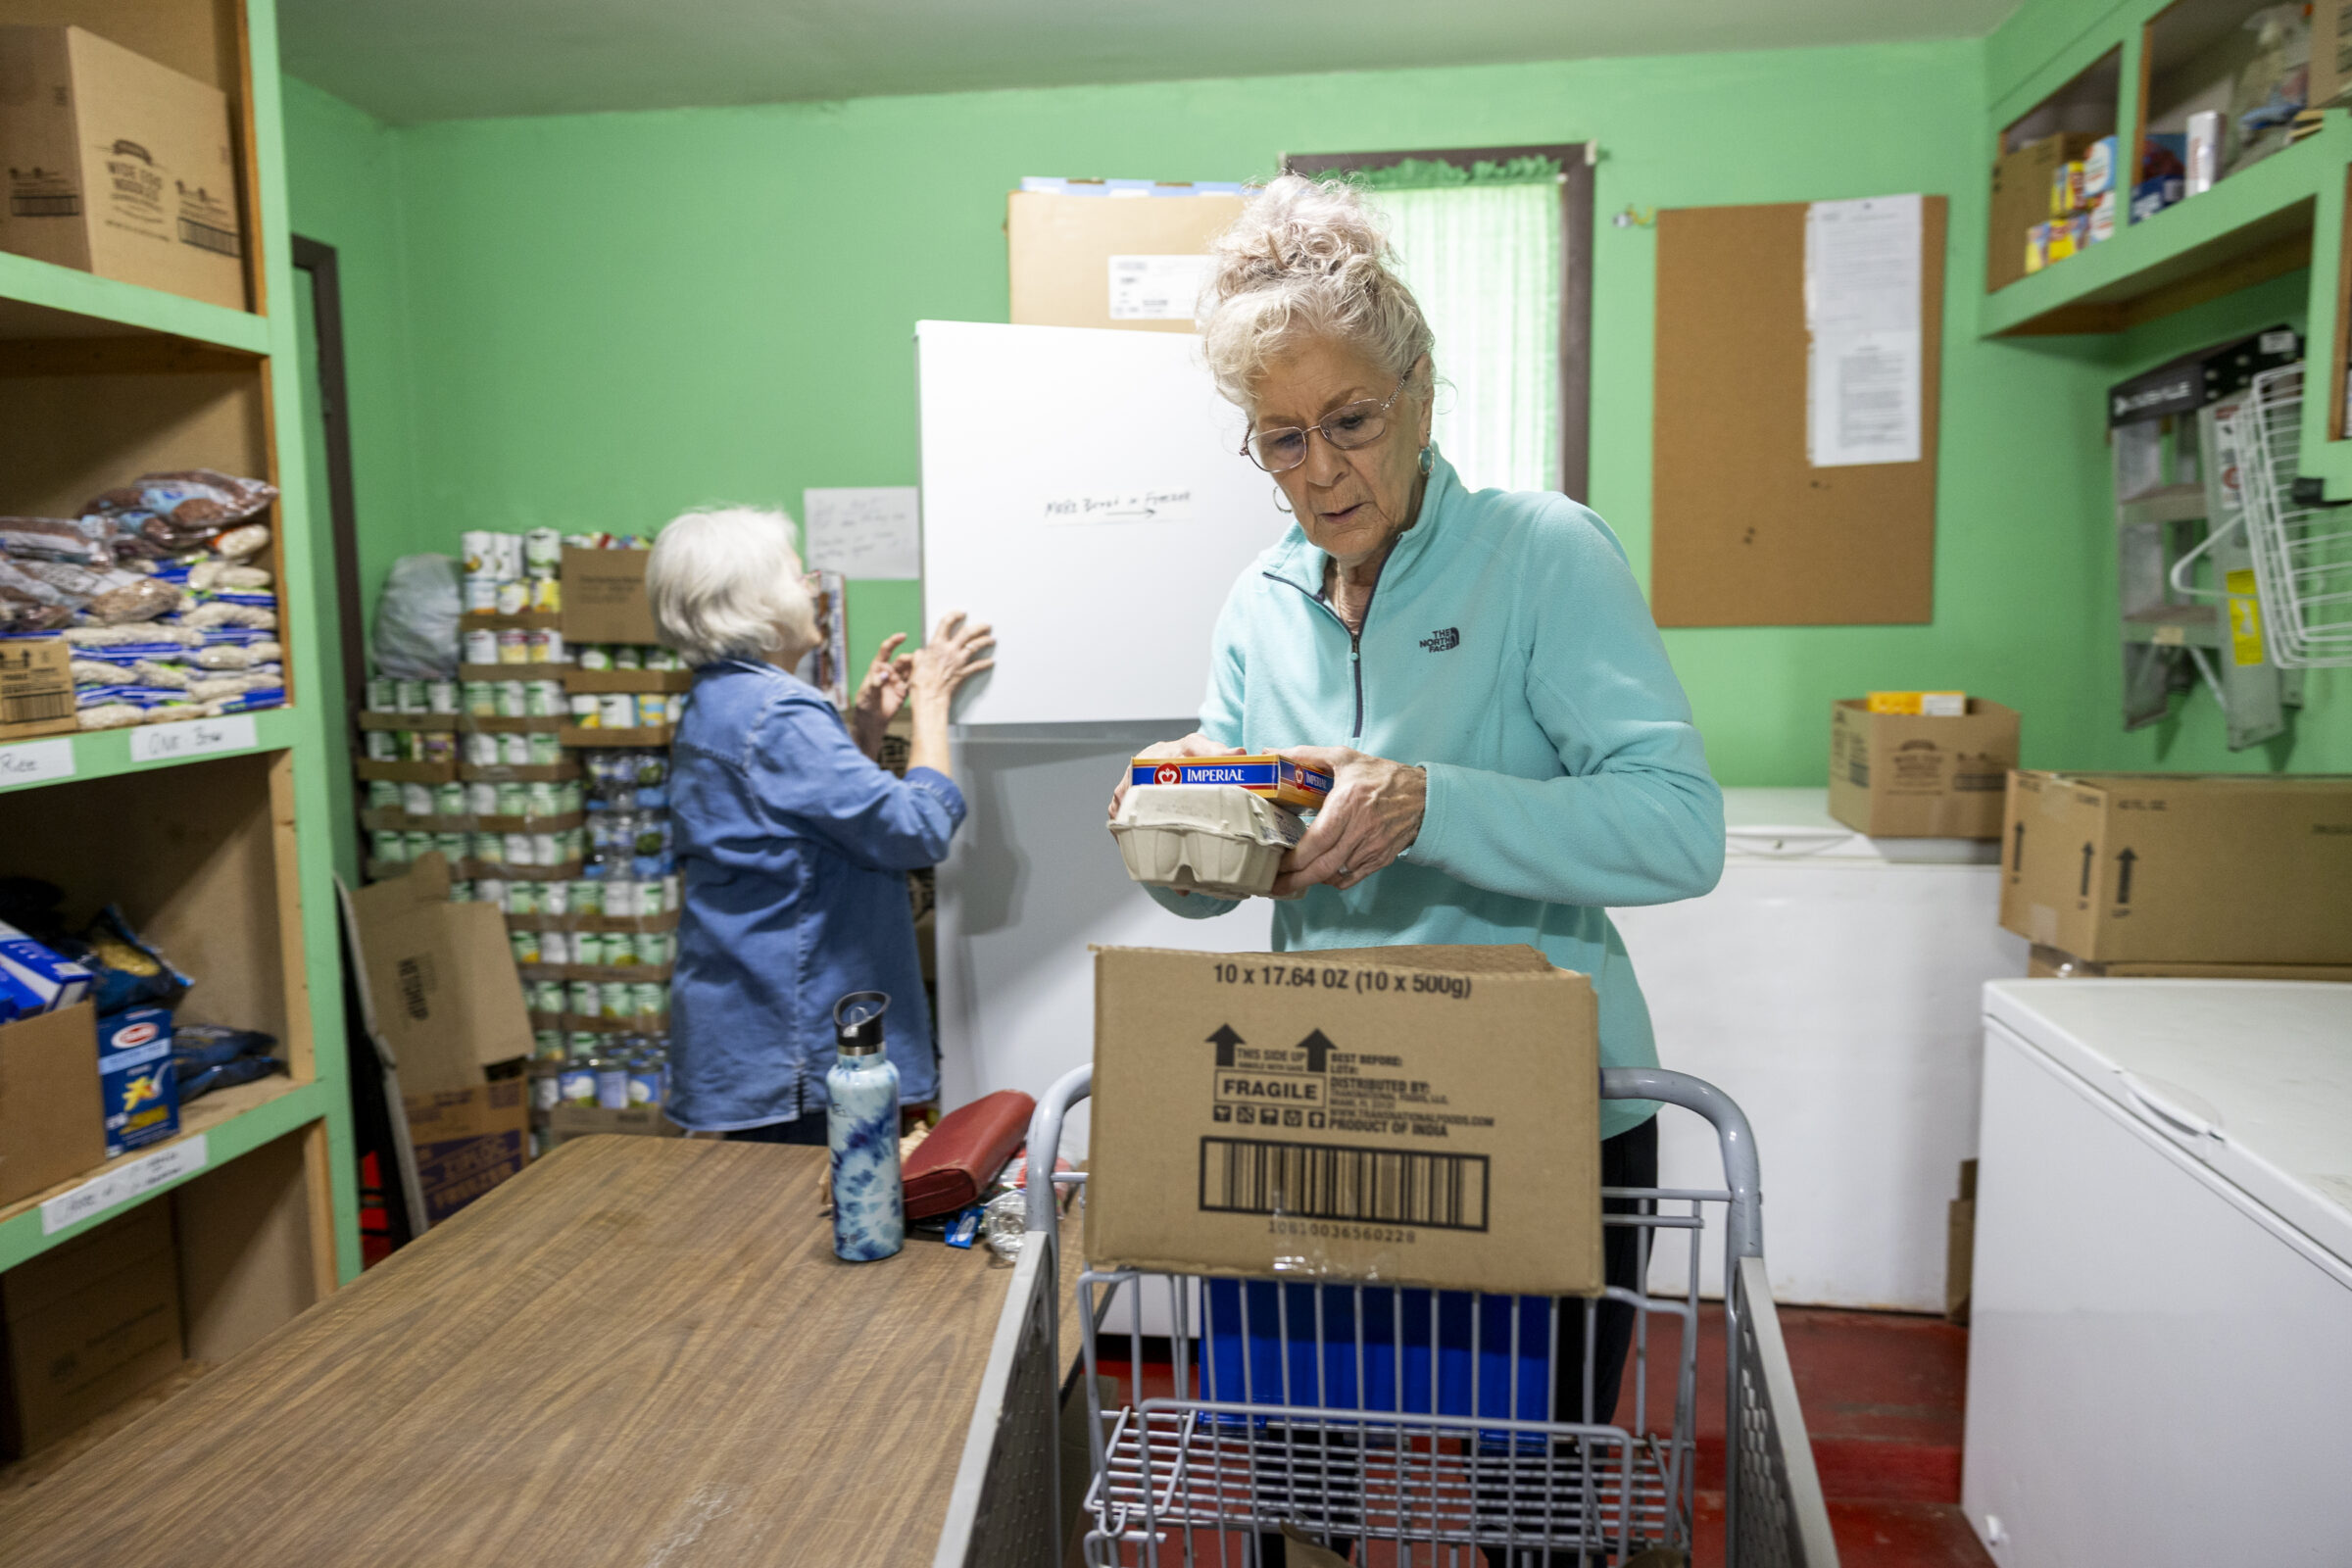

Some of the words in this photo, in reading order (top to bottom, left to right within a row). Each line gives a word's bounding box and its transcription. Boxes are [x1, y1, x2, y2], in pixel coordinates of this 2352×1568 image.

[1432, 628, 1450, 638] THE
[1419, 637, 1450, 648] NORTH
[1429, 643, 1452, 653] FACE
[1187, 768, 1245, 782] IMPERIAL
[1214, 964, 1237, 984] 10
[1244, 968, 1255, 985] x
[1262, 966, 1316, 988] 17.64
[1322, 968, 1348, 989] OZ
[1355, 970, 1389, 995] (10
[1395, 974, 1406, 993] x
[1412, 974, 1472, 1000] 500g)
[1237, 1048, 1260, 1060] THIS
[1263, 1049, 1288, 1061] SIDE
[1291, 1051, 1306, 1062] UP
[1331, 1053, 1356, 1063] BEST
[1359, 1054, 1402, 1067] BEFORE:
[1224, 1079, 1318, 1100] FRAGILE
[1331, 1077, 1407, 1093] DISTRIBUTED
[1410, 1081, 1430, 1094] BY:
[1330, 1117, 1388, 1133] PRODUCT
[1392, 1121, 1407, 1134] OF
[1412, 1124, 1448, 1137] INDIA
